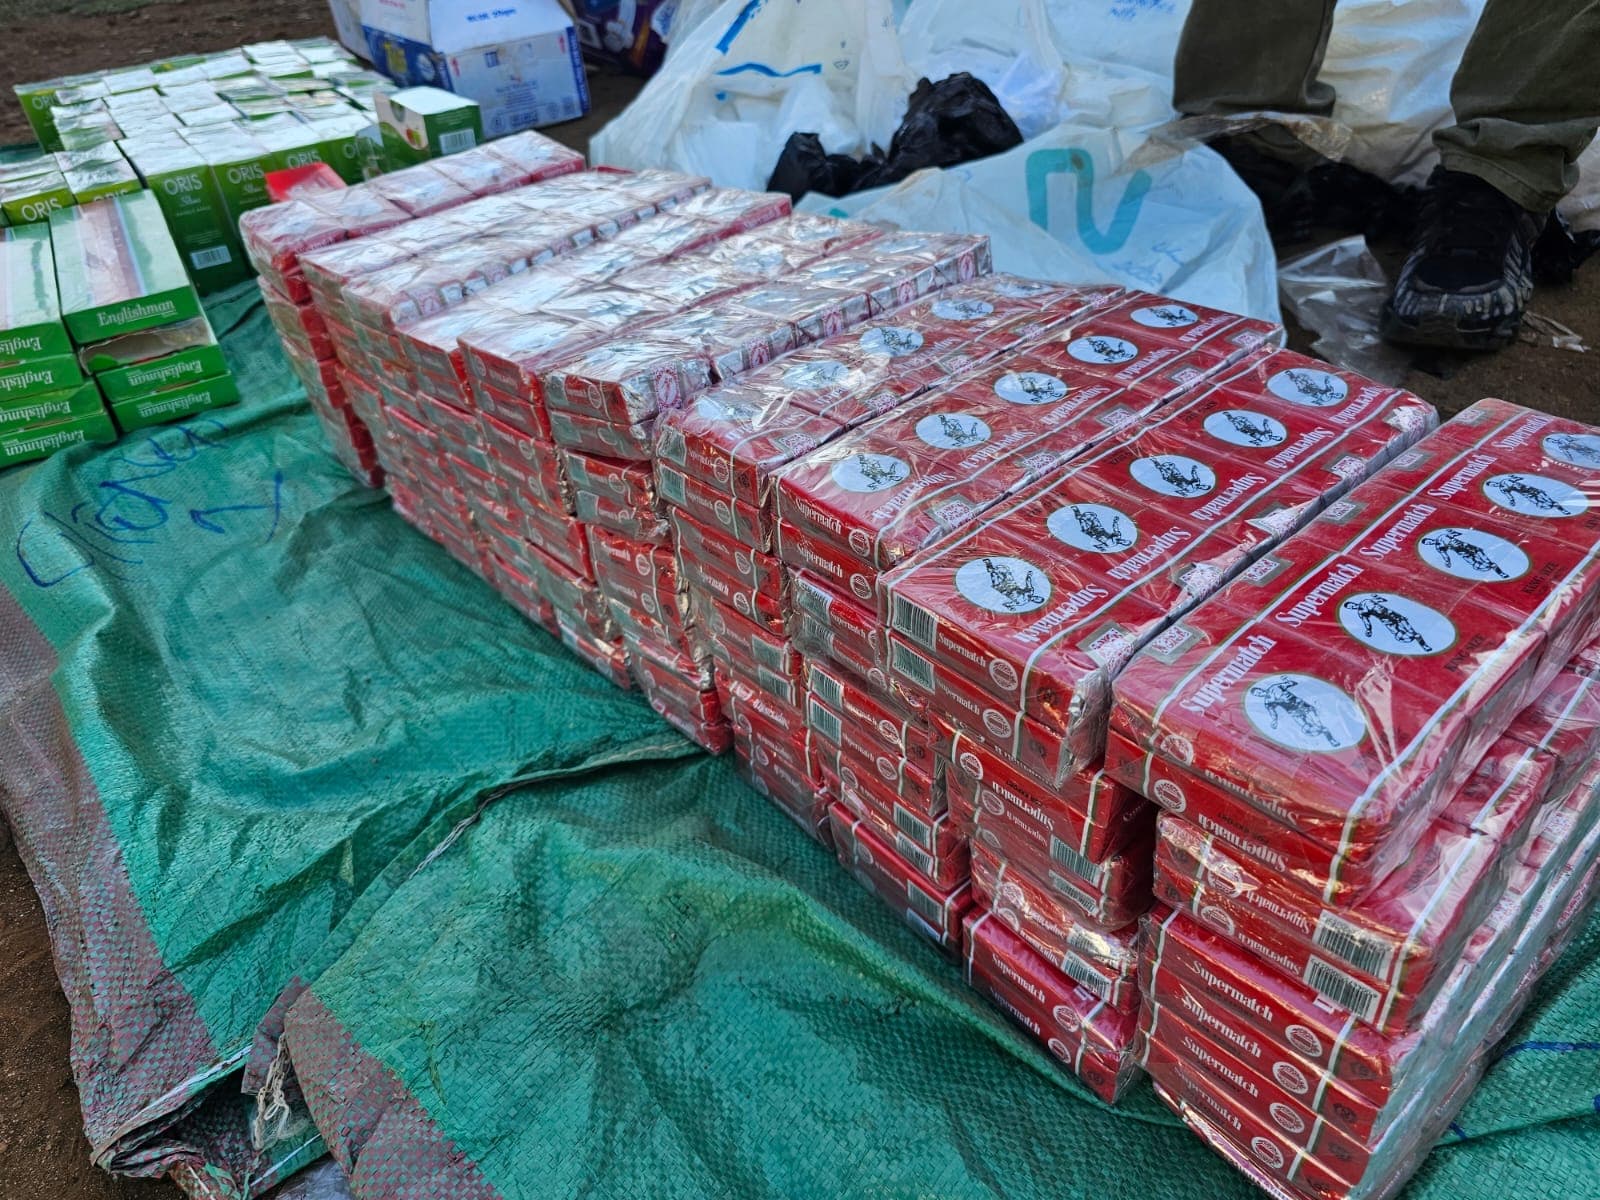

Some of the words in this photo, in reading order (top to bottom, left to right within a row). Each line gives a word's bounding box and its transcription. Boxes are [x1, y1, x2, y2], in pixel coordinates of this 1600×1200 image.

[164, 174, 203, 196] ORIS
[227, 163, 265, 185] ORIS
[21, 197, 62, 222] ORIS
[96, 300, 176, 327] Englishman
[0, 371, 54, 390] English
[129, 360, 203, 386] Englishman
[1114, 349, 1180, 380] Supermatch
[138, 392, 212, 418] Englishman
[1040, 385, 1111, 425] Supermatch
[6, 430, 85, 457] Englishman
[959, 430, 1037, 470] Supermatch
[1264, 426, 1336, 469] Supermatch
[1491, 414, 1552, 452] Supermatch
[1190, 472, 1267, 521] Supermatch
[1427, 453, 1499, 501] Supermatch
[1106, 526, 1192, 580] Supermatch
[1361, 502, 1438, 561] Supermatch
[1013, 584, 1109, 643] Supermatch
[1275, 562, 1365, 628] Supermatch
[937, 632, 987, 668] Supermatch
[1179, 633, 1278, 715] Supermatch
[991, 780, 1056, 832] Supermatch
[1203, 768, 1300, 827] Supermatch
[1005, 809, 1049, 848] Supermatch
[1197, 812, 1290, 874] Supermatch
[1245, 890, 1313, 936] Supermatch
[1237, 932, 1302, 976] Supermatch
[991, 952, 1046, 1004] Supermatch
[1191, 959, 1275, 1023] Supermatch
[988, 985, 1042, 1036] Supermatch
[1180, 994, 1263, 1060] Supermatch
[1181, 1035, 1260, 1099] Supermatch
[1174, 1064, 1244, 1132] Supermatch
